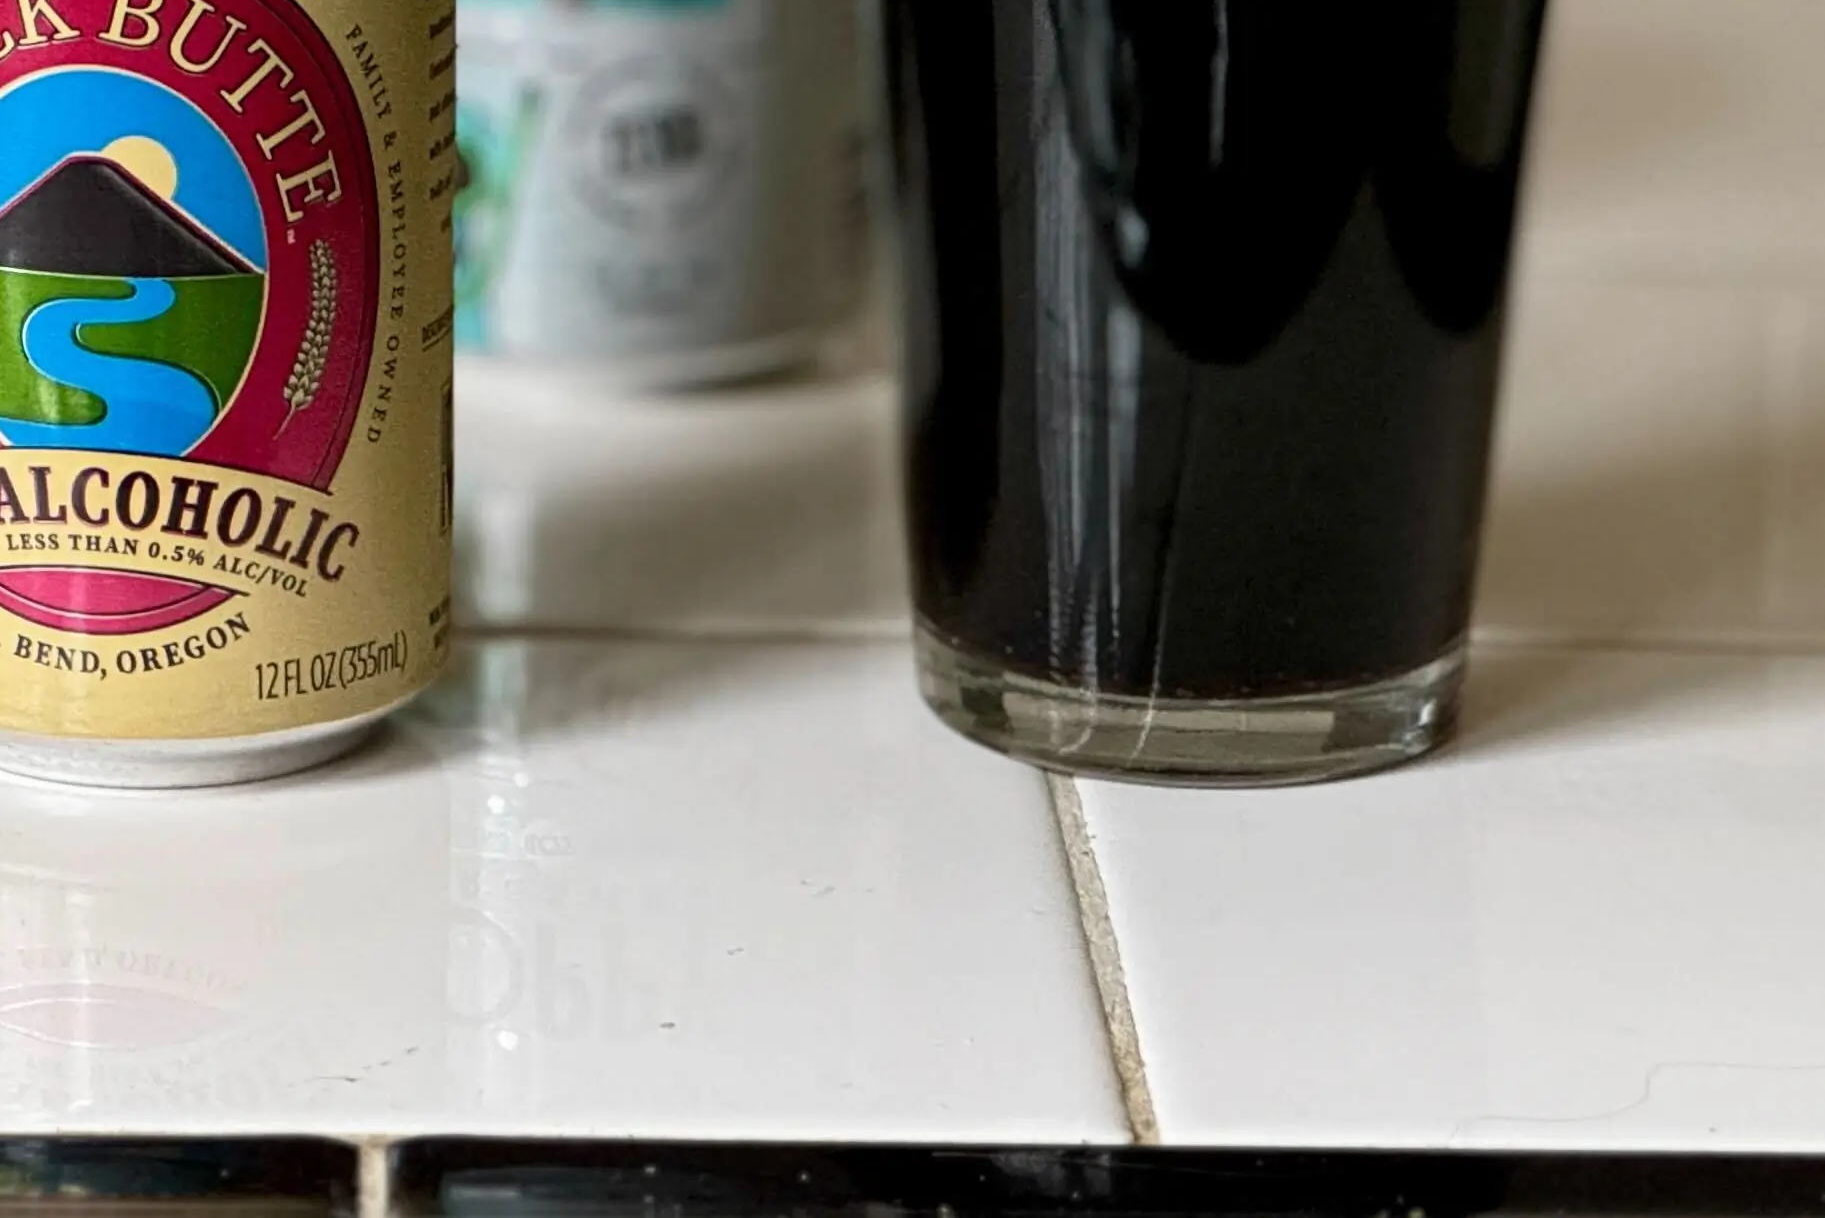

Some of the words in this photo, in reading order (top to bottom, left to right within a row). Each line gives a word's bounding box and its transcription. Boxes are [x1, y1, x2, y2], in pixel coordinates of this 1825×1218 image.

[344, 23, 392, 119] FAMILY
[382, 130, 397, 151] &
[387, 161, 407, 320] EMPLOYEE
[366, 335, 400, 443] OWNED
[7, 533, 60, 551] LESS
[68, 534, 139, 556] THAN
[148, 541, 205, 567] 0.5%
[213, 553, 308, 598] ALC/VOL
[13, 633, 108, 681] BEND,
[116, 611, 252, 675] OREGON
[255, 661, 279, 701] 12
[283, 657, 309, 698] FL
[310, 651, 337, 692] OZ
